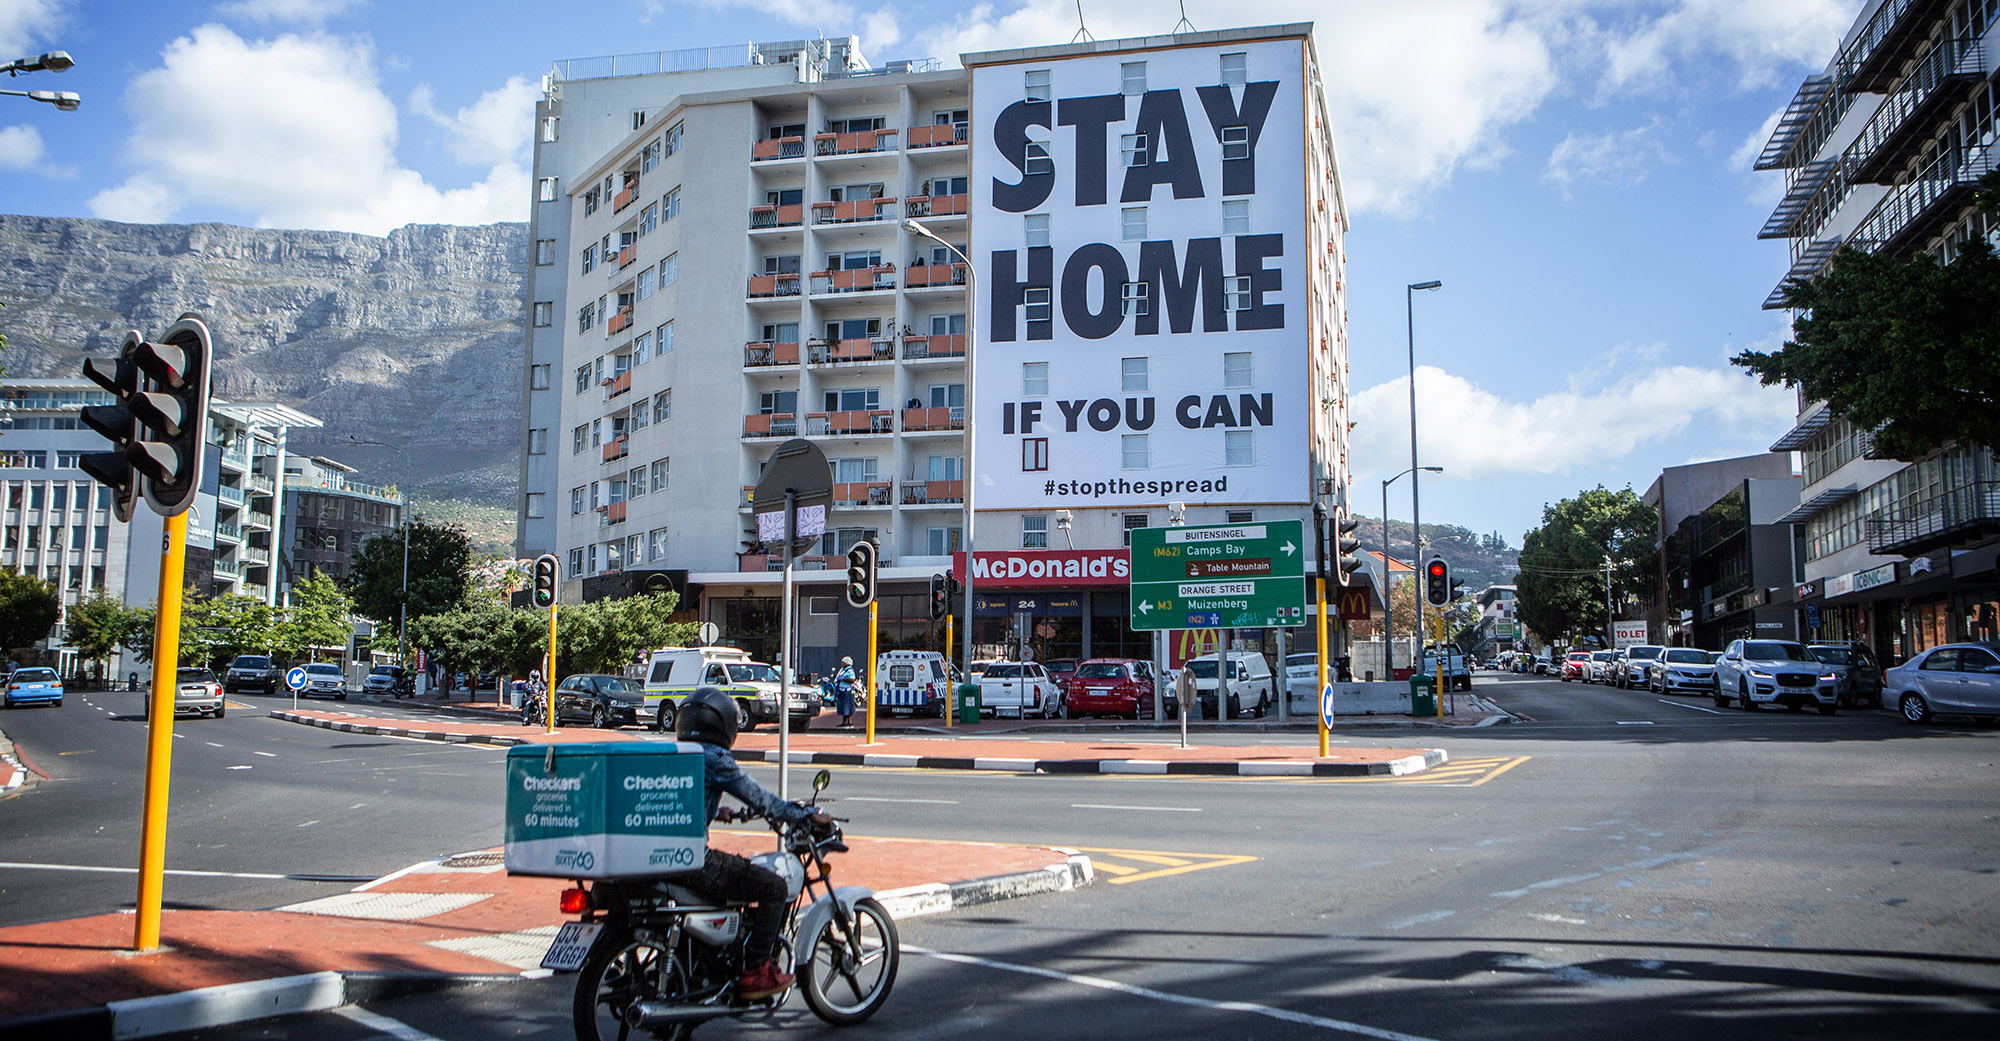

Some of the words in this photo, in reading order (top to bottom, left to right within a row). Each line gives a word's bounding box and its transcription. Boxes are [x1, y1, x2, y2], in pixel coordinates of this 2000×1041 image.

[992, 80, 1280, 213] STAY
[991, 233, 1285, 343] HOME
[1003, 402, 1042, 434] IF
[1056, 397, 1155, 433] YOU
[1176, 393, 1274, 431] CAN
[1044, 475, 1227, 500] #stopthespread
[1185, 530, 1246, 540] BUITENSINGEL
[1154, 547, 1180, 557] (M62)
[1187, 546, 1221, 556] Camps
[1226, 544, 1245, 555] Bay
[966, 556, 1129, 579] McDonald's
[1206, 563, 1229, 573] Table
[1231, 561, 1270, 572] Mountain
[1181, 585, 1216, 595] ORANGE
[1219, 584, 1251, 594] STREET
[1018, 600, 1036, 608] 24
[1158, 601, 1173, 610] M3
[1188, 599, 1248, 610] Muizenberg
[1188, 616, 1205, 624] (N2)
[1616, 630, 1628, 638] TO
[1630, 630, 1645, 638] LET
[523, 776, 581, 791] Checkers
[624, 775, 694, 790] Checkers
[536, 792, 567, 802] groceries
[640, 791, 678, 803] groceries
[533, 803, 564, 812] delivered
[565, 804, 571, 812] in
[635, 801, 674, 812] delivered
[676, 801, 683, 811] in
[525, 813, 538, 827] 60
[540, 814, 579, 828] minutes
[625, 813, 641, 827] 60
[645, 812, 692, 826] minutes
[558, 925, 584, 944] JJ4
[547, 946, 587, 964] 6KGGP
